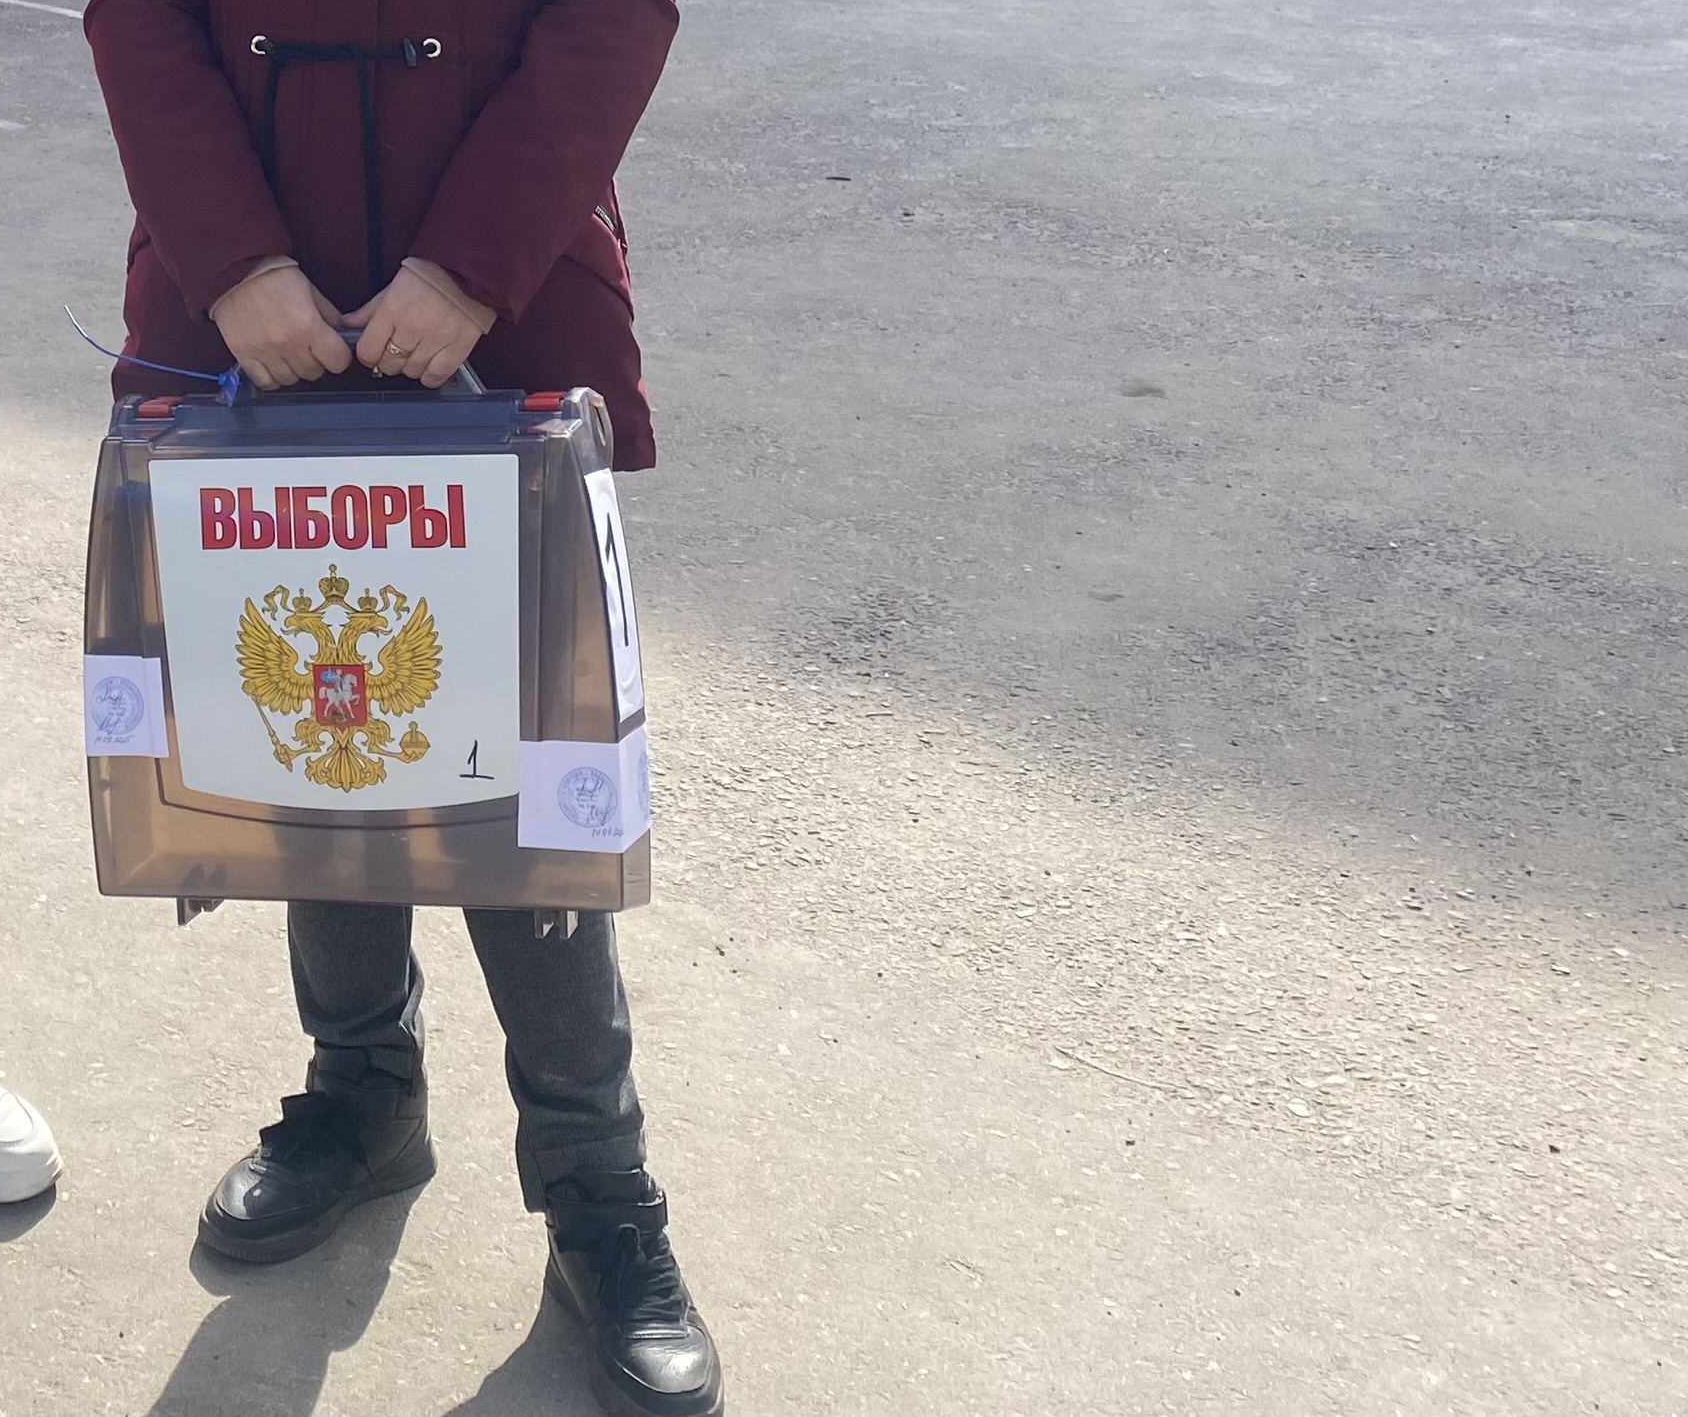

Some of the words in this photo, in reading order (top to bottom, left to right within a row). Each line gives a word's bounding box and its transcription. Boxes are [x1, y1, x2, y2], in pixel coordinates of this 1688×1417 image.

[199, 484, 467, 550] ВЫБОРЫ
[605, 512, 629, 647] 1
[459, 739, 495, 780] 1
